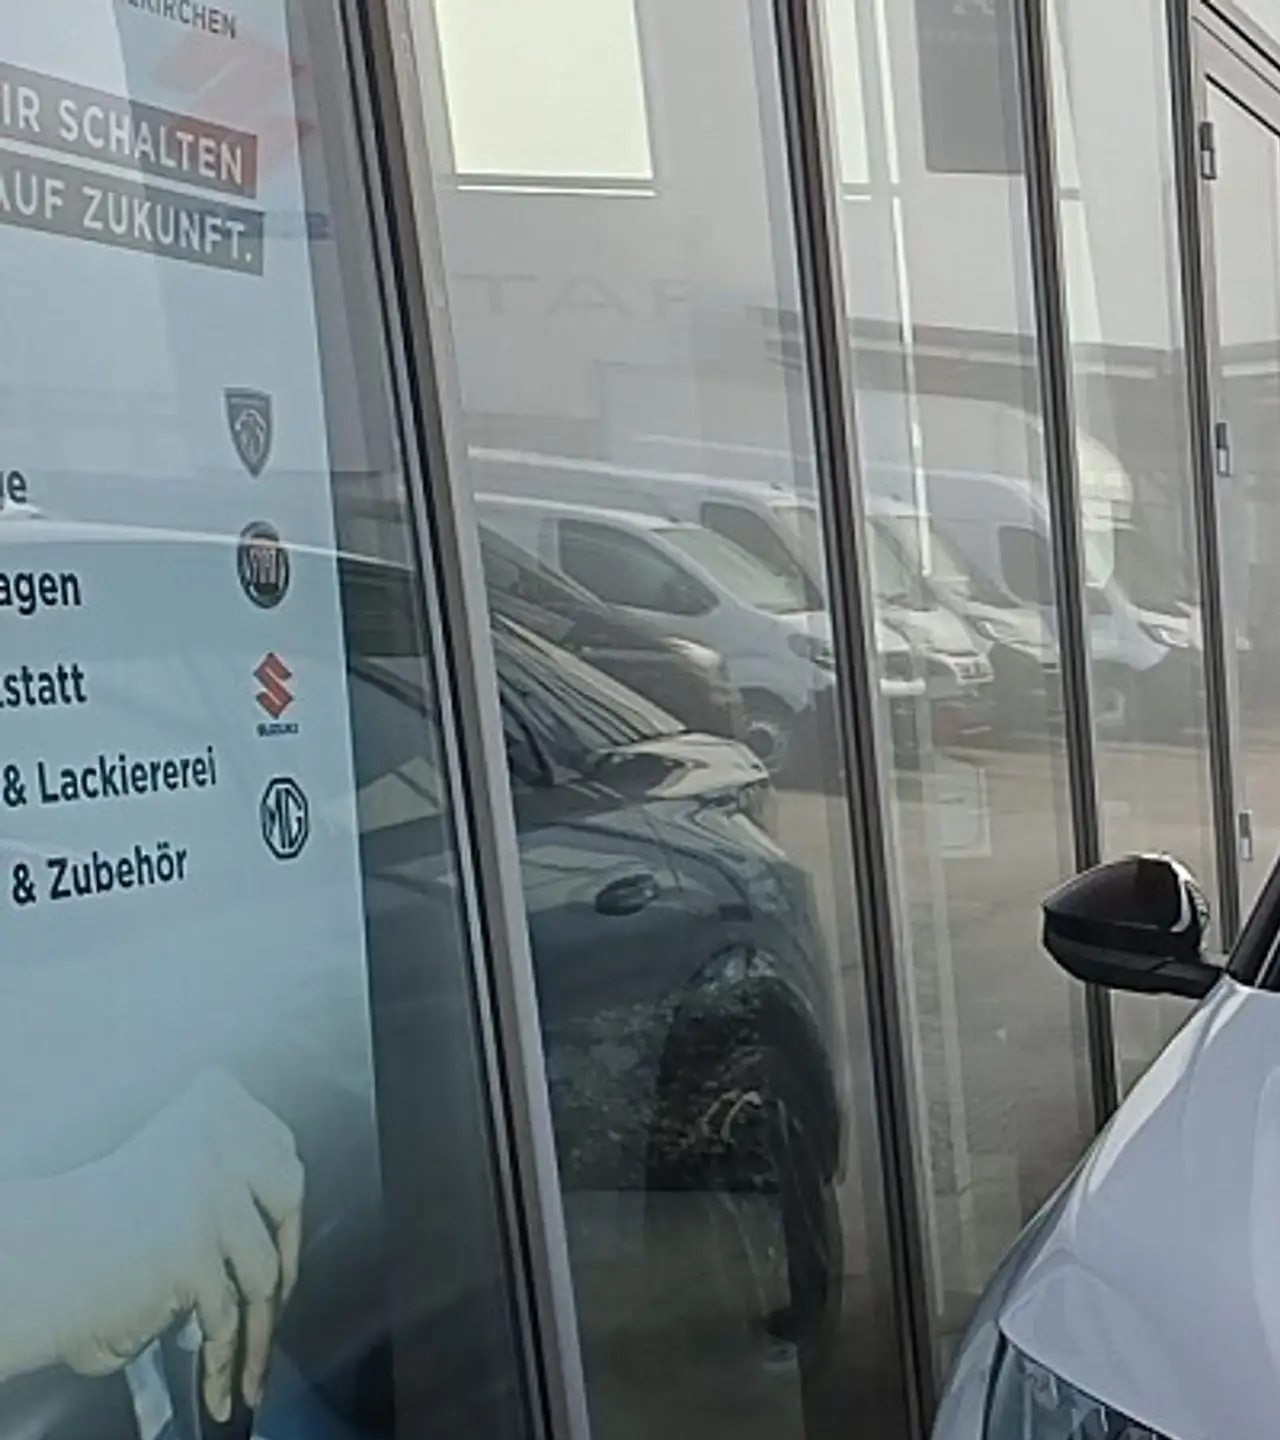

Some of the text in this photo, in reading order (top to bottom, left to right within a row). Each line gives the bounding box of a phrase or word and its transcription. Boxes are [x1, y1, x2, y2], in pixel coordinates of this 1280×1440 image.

[58, 97, 243, 186] SCHALTEN
[82, 186, 253, 262] ZUKUNFT.
[0, 468, 28, 510] e
[0, 663, 88, 709] statt
[2, 745, 218, 808] & Lackiererei
[12, 840, 188, 906] & Zubehör
